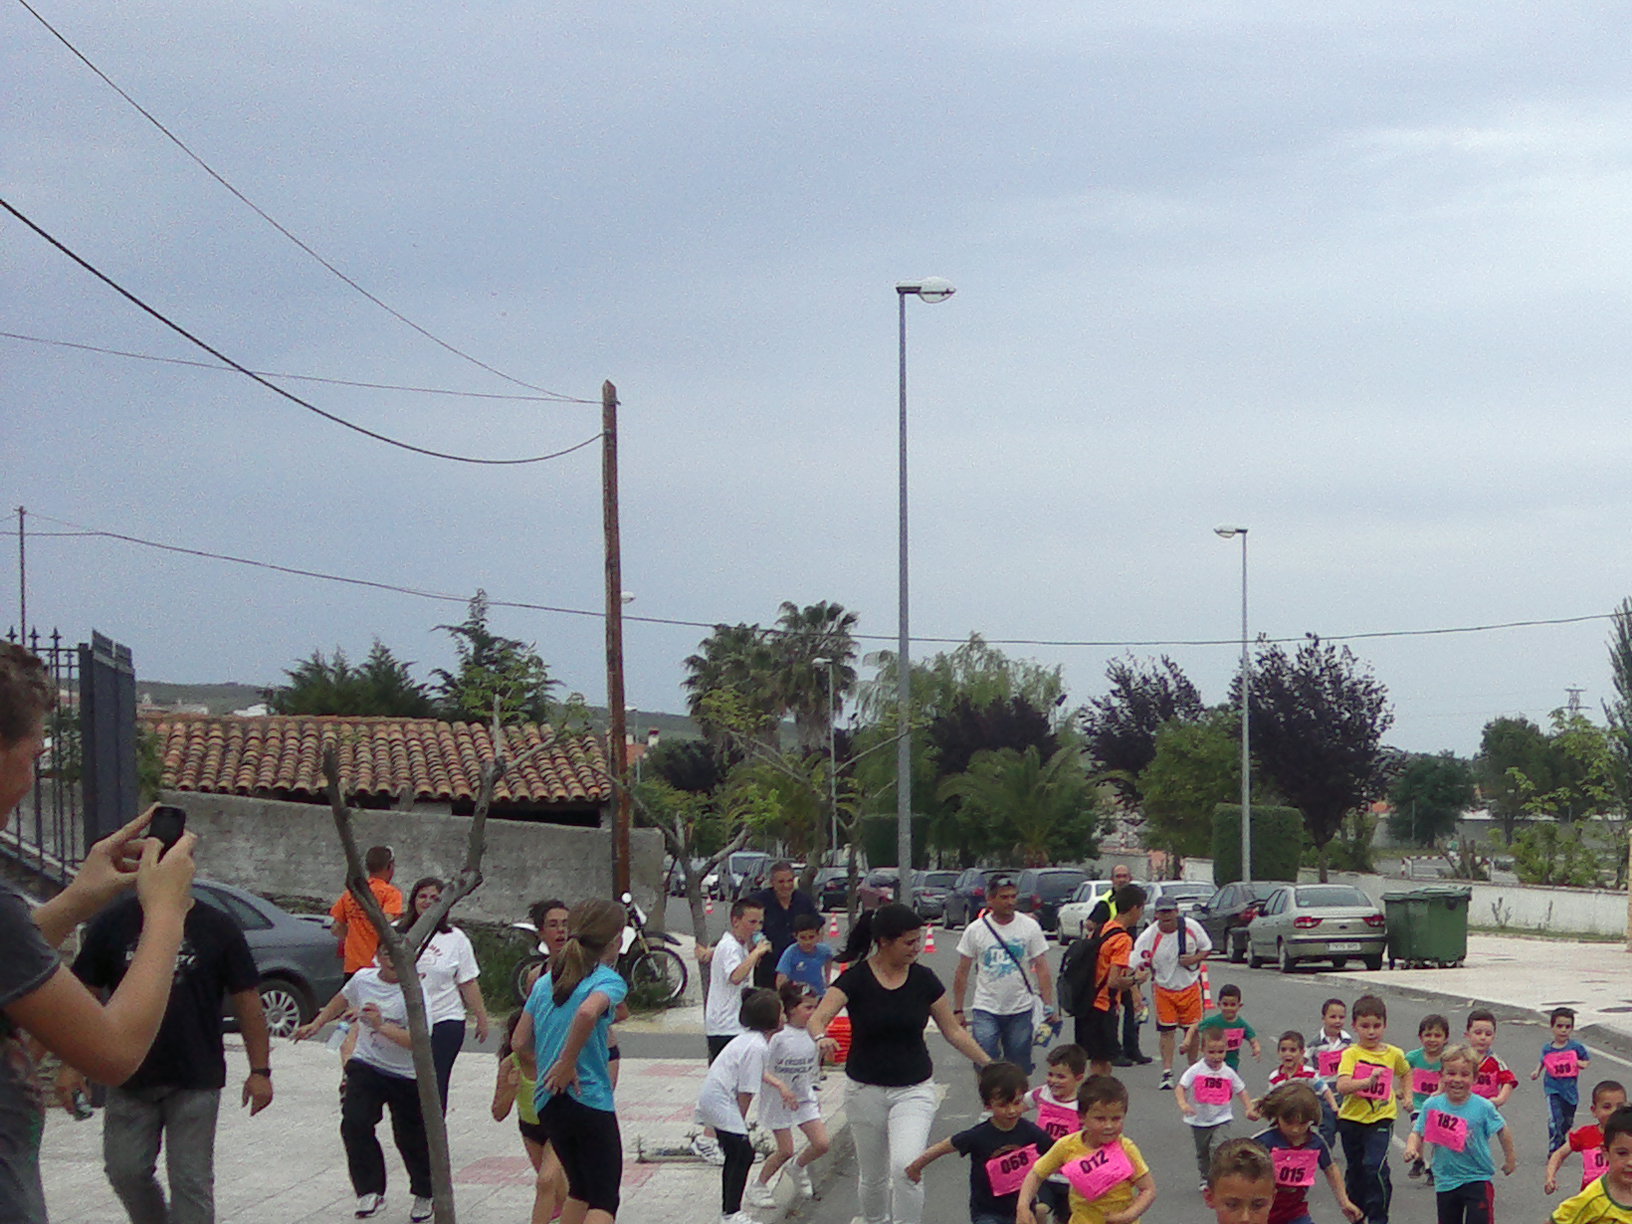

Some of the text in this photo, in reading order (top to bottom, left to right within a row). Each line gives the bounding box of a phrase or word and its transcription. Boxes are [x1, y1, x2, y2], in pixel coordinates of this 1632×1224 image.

[1438, 1113, 1459, 1131] 182
[1001, 1151, 1029, 1174] 068
[1079, 1150, 1109, 1174] 012
[1279, 1166, 1306, 1182] 015
